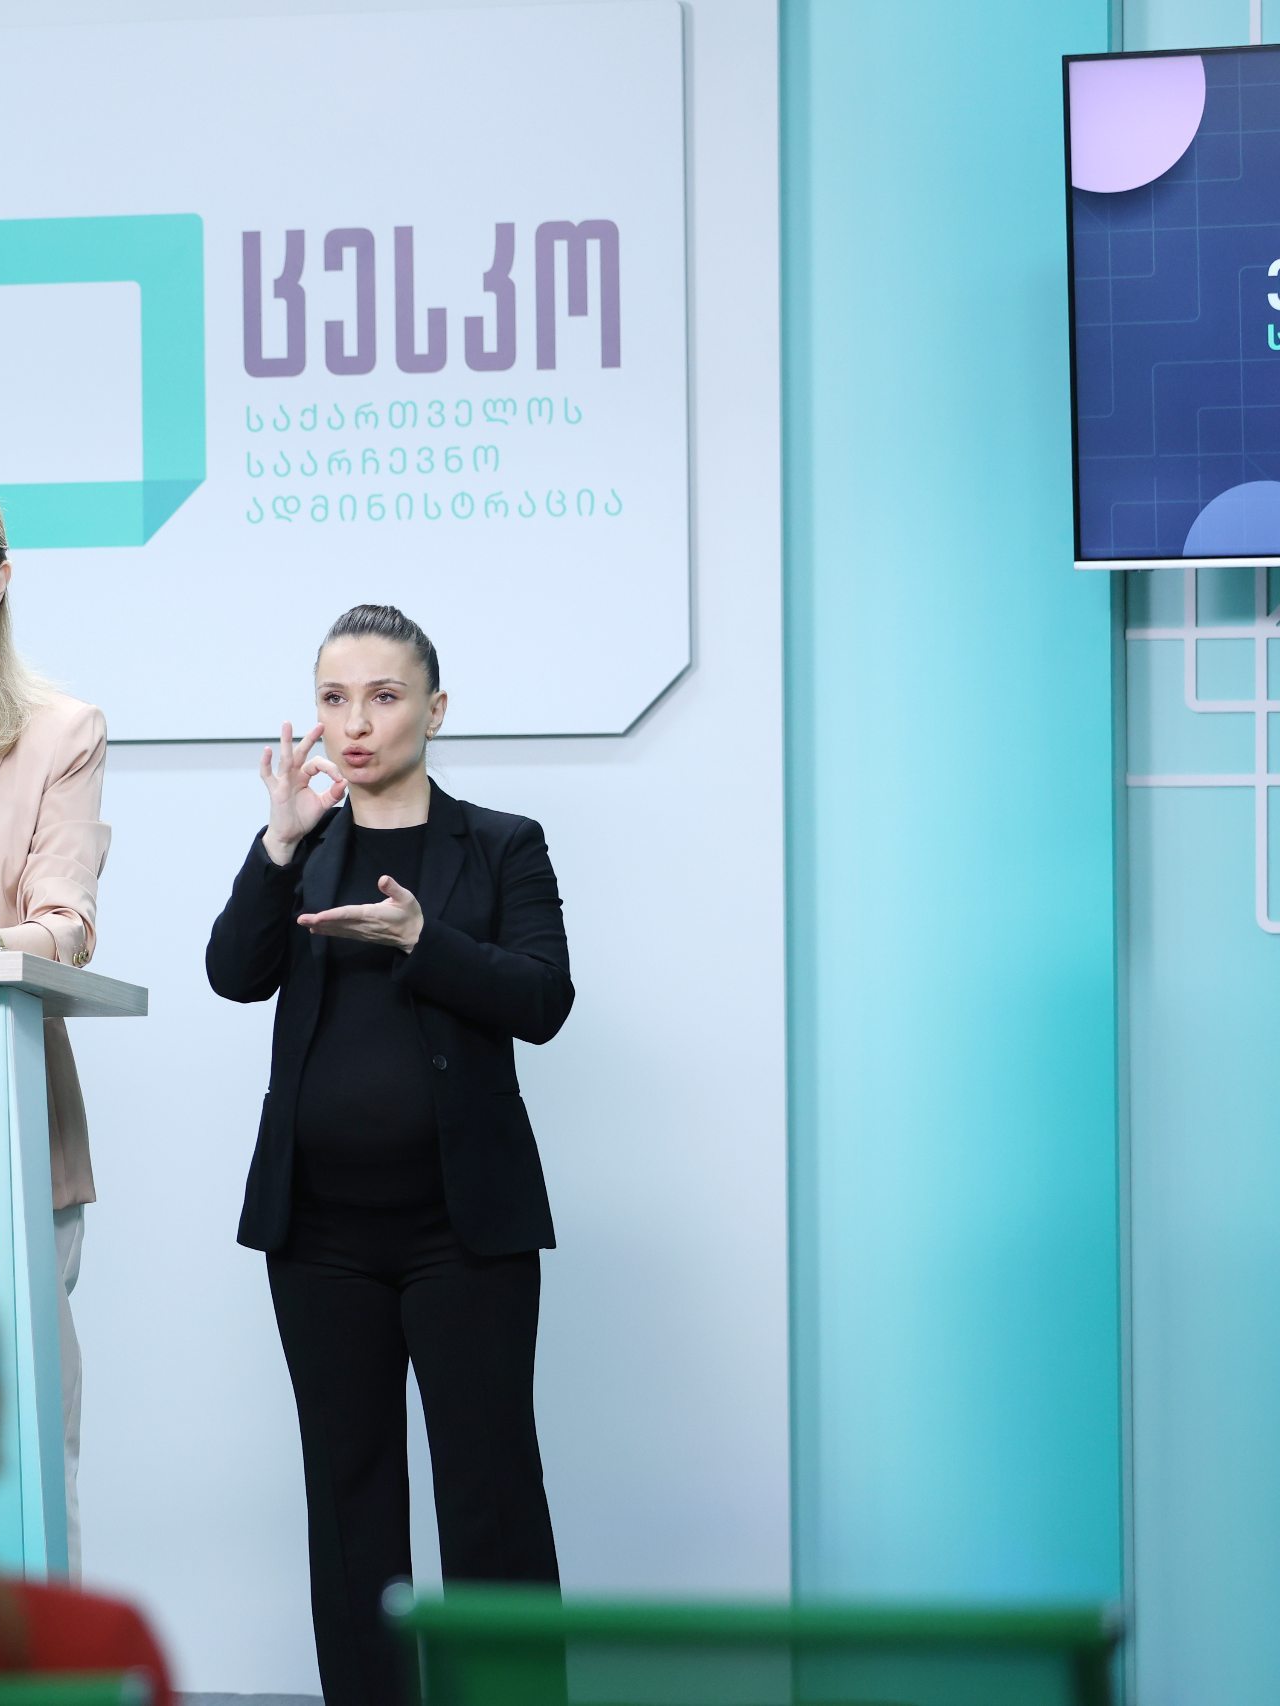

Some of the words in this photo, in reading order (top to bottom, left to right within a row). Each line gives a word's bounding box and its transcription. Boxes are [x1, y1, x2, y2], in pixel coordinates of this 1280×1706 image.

[242, 219, 621, 378] ცესკო
[245, 396, 583, 433] საქართველოს
[245, 445, 500, 478] საარჩევნო
[245, 488, 623, 525] ადმინისტრაცია
